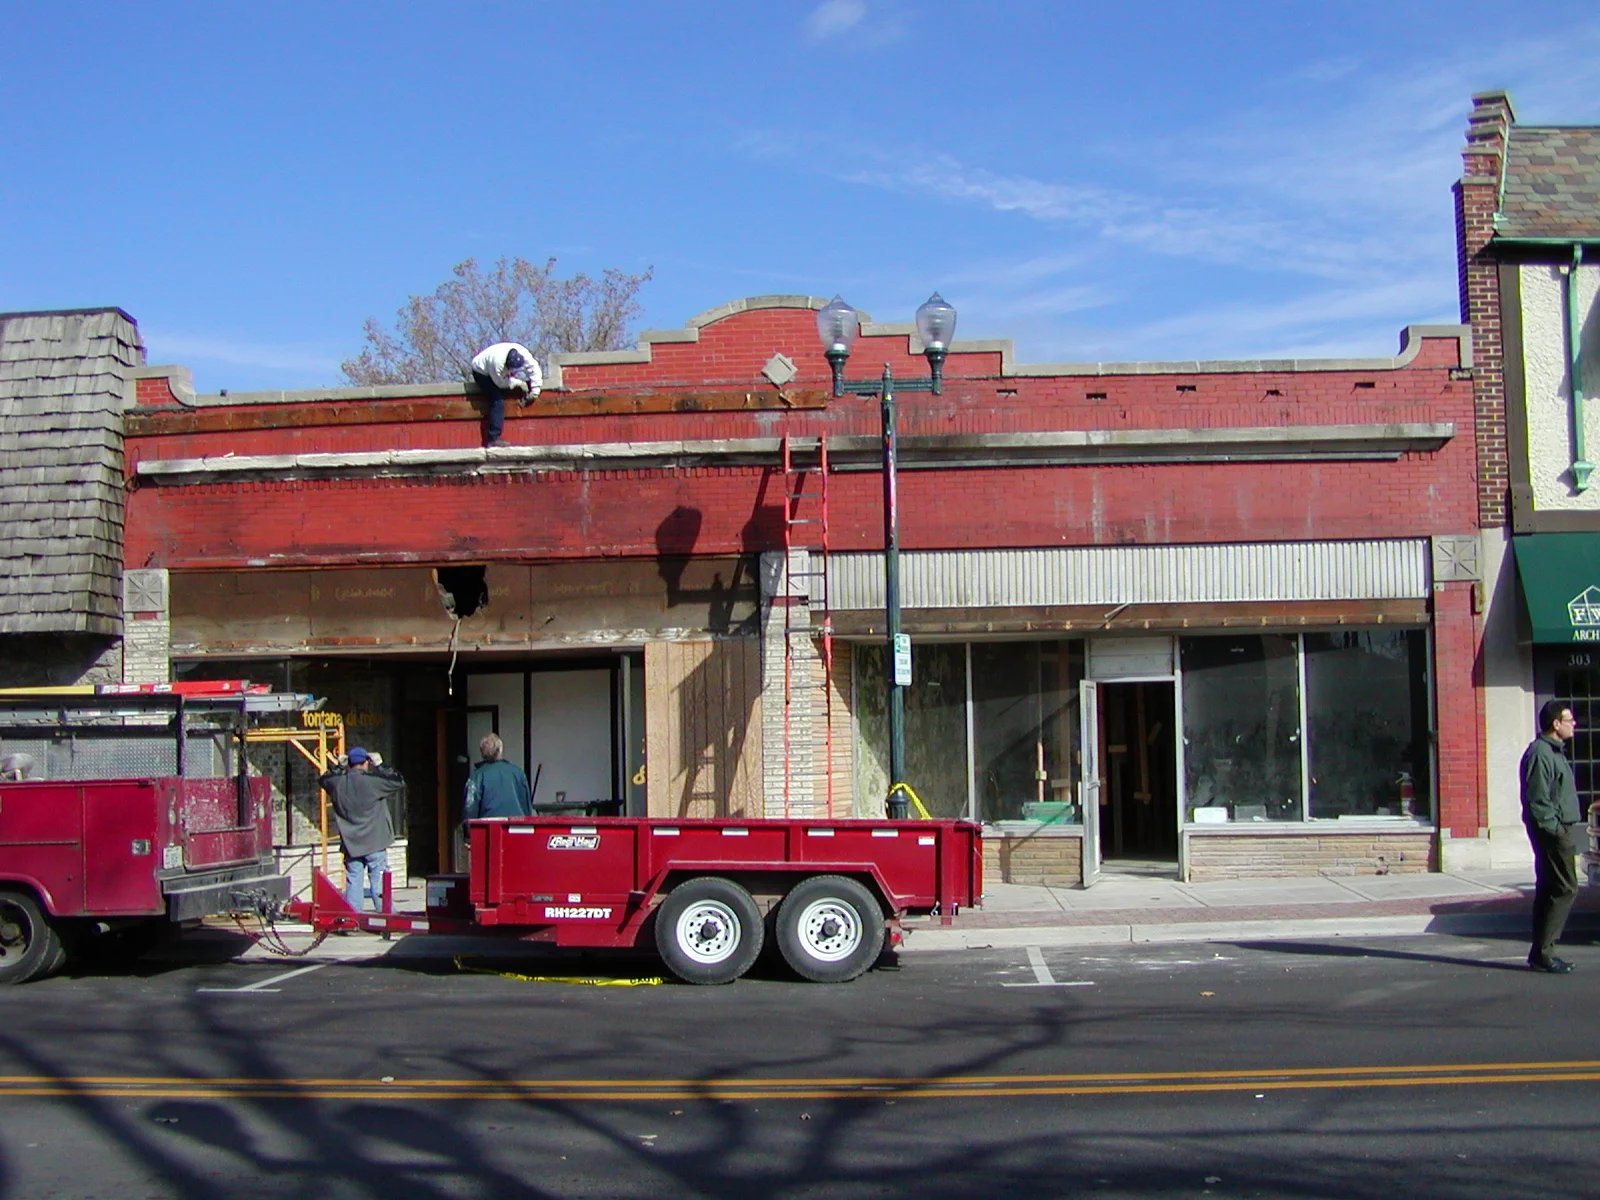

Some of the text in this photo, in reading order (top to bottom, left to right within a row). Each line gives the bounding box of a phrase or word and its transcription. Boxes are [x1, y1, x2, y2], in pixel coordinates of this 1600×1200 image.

[1573, 629, 1600, 641] ARCH
[1568, 654, 1591, 667] 303
[302, 710, 343, 728] fontana
[544, 907, 612, 919] RH1227DT
